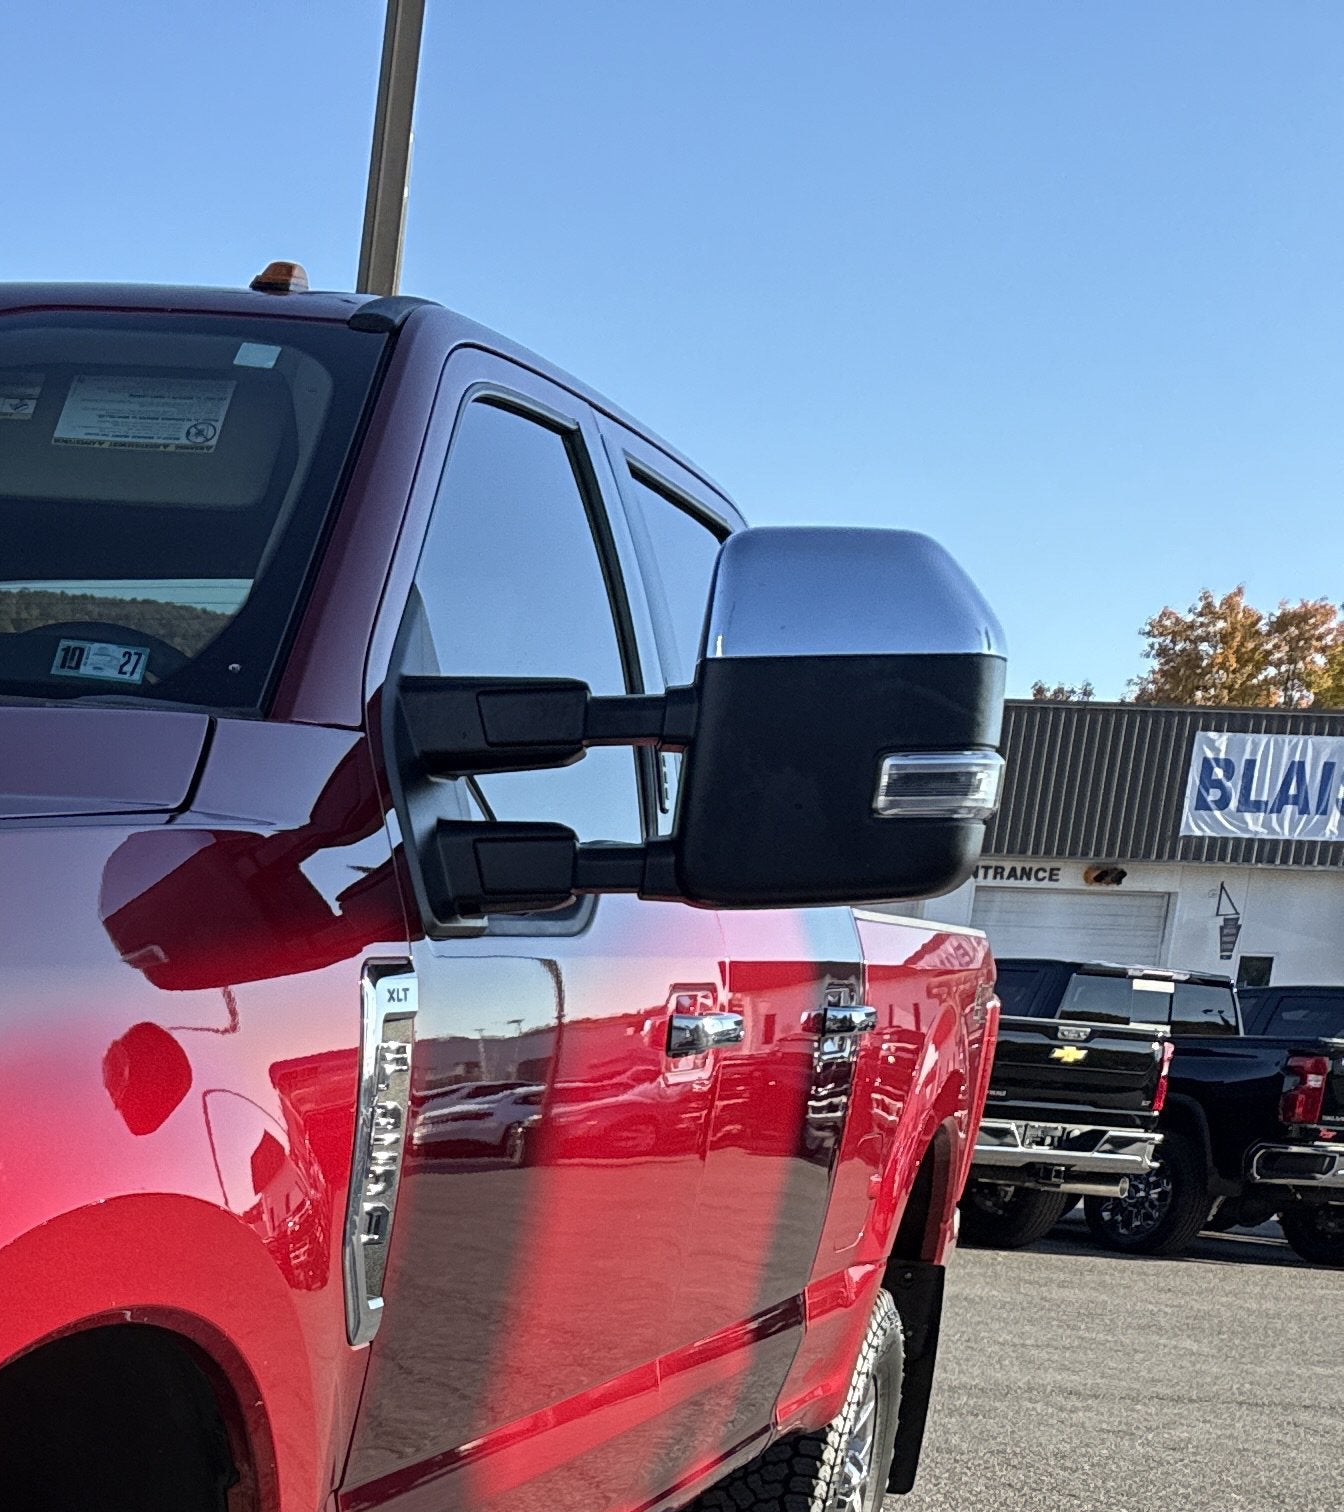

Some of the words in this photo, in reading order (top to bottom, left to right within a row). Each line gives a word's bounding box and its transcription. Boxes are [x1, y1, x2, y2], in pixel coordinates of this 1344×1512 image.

[59, 646, 85, 670] 10
[118, 651, 143, 677] 27
[1194, 756, 1344, 816] BLAI
[387, 987, 410, 1003] XLT
